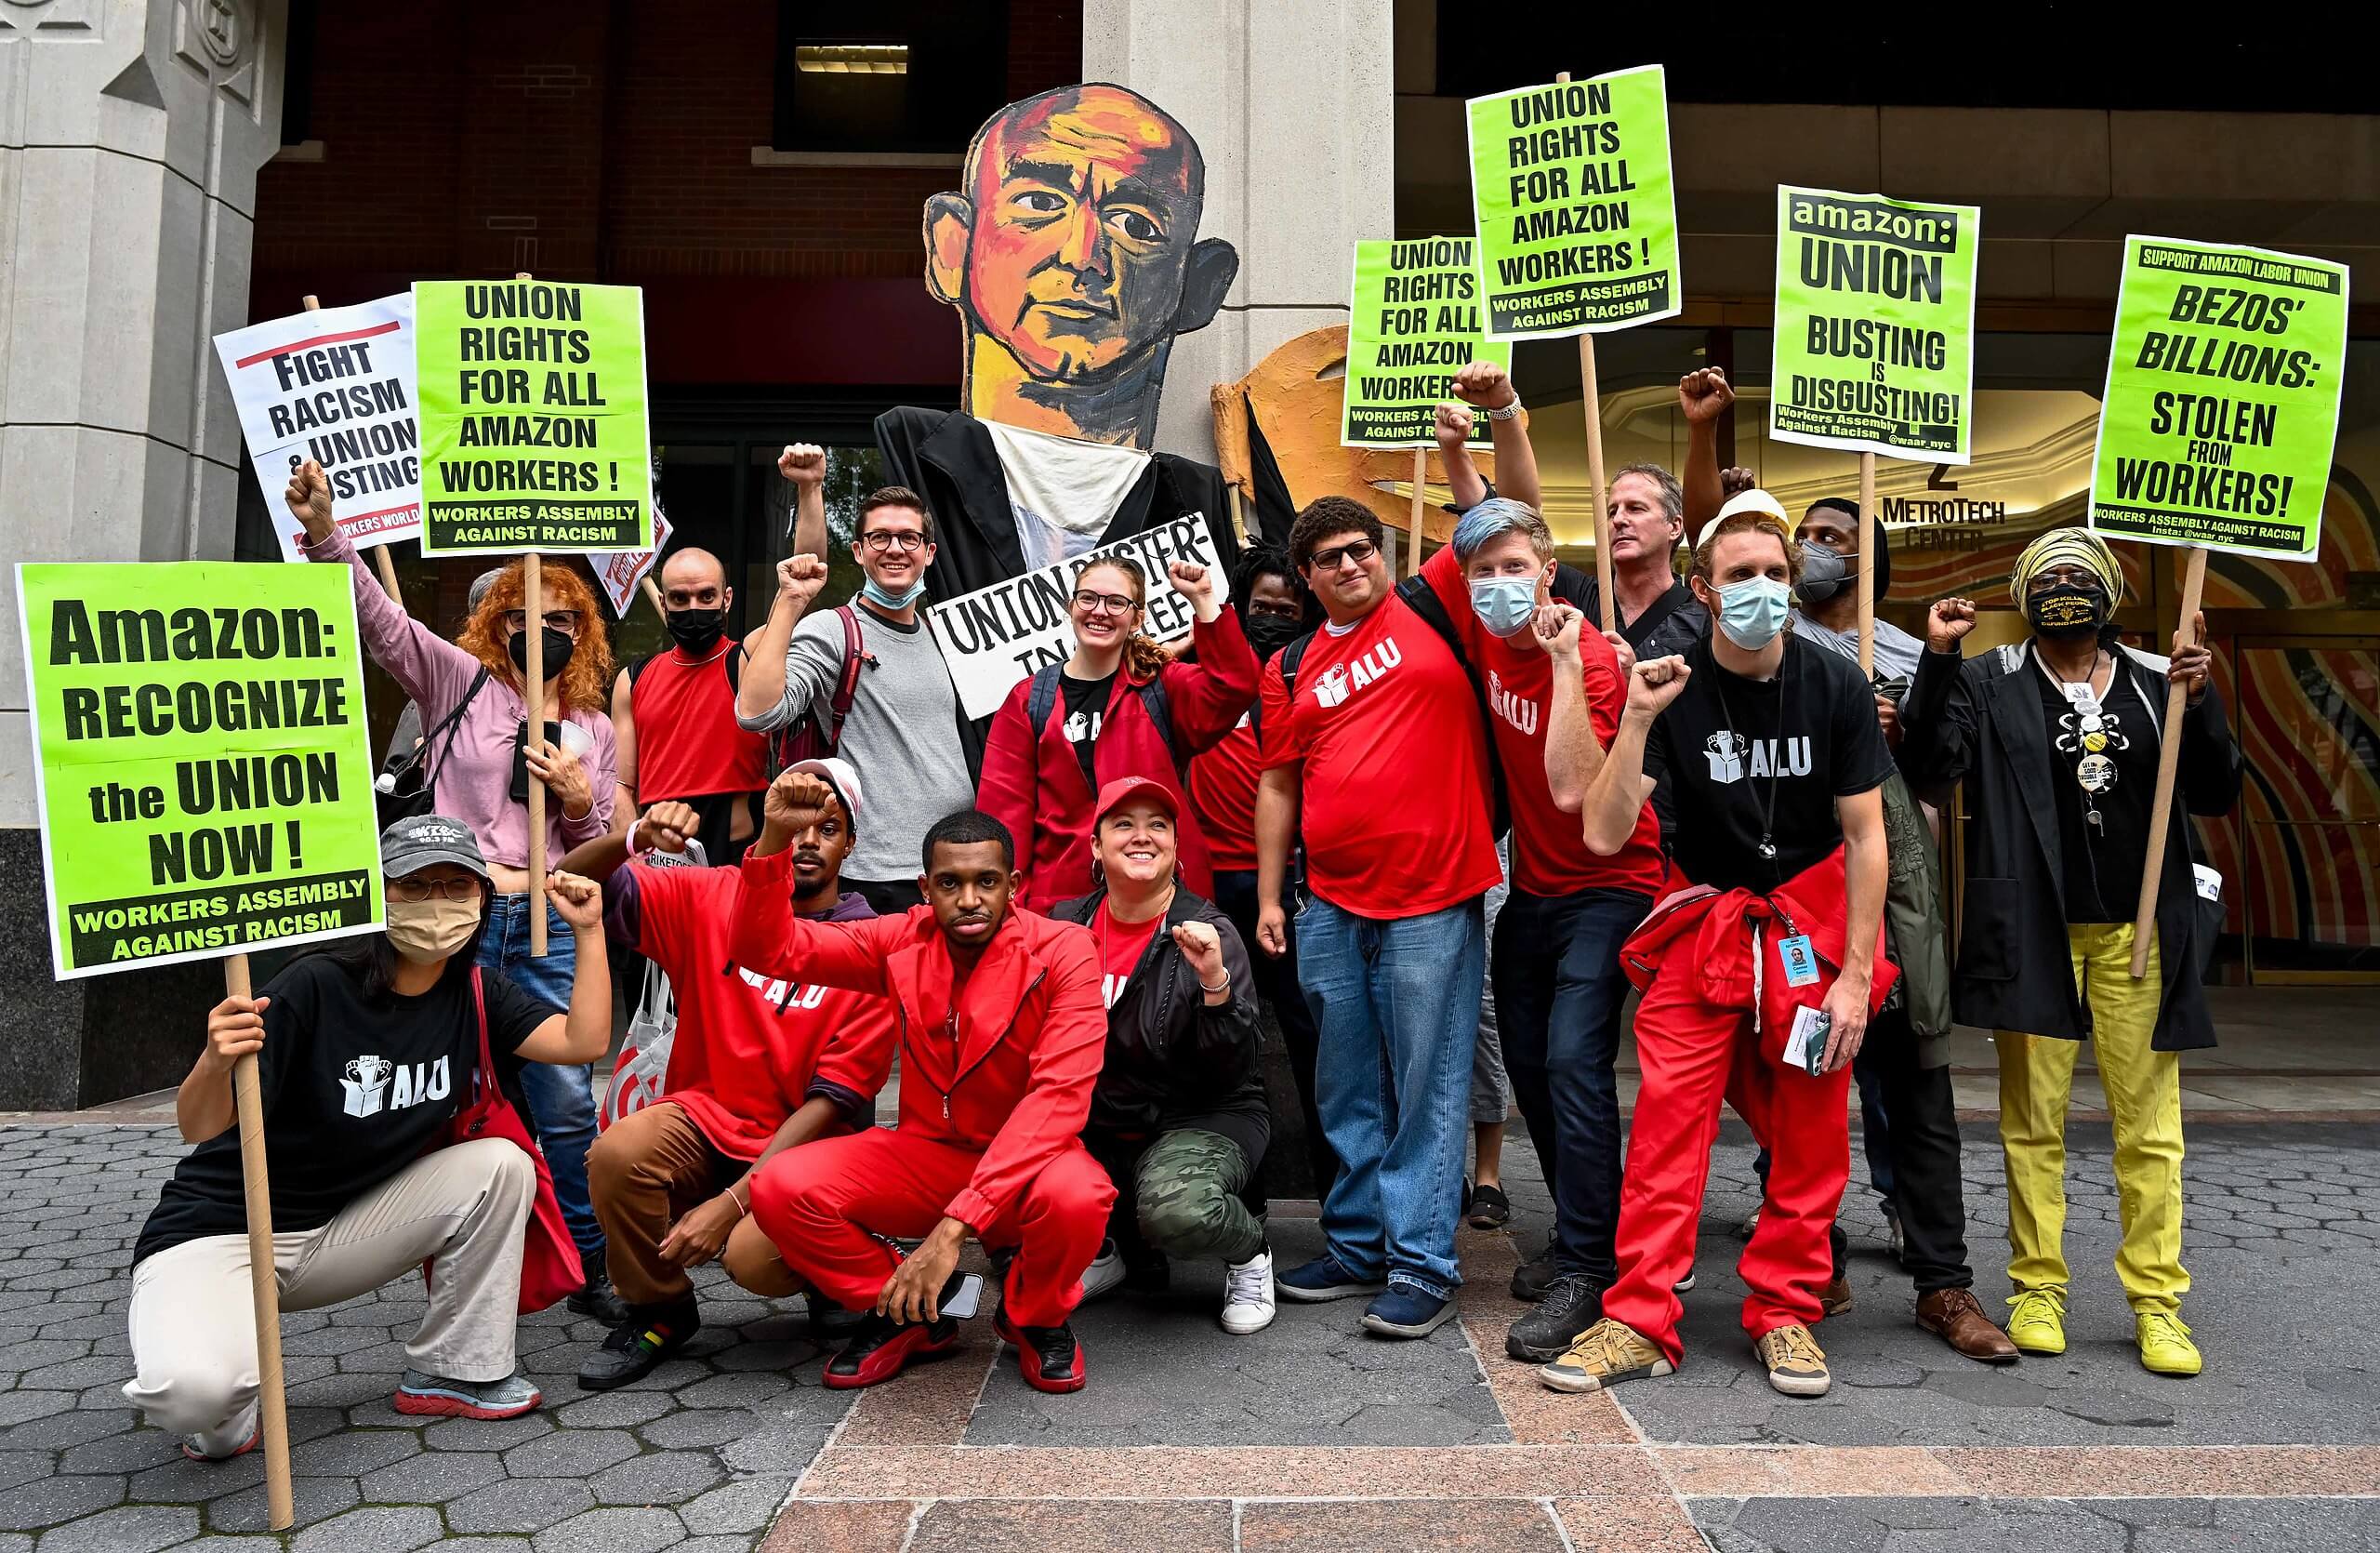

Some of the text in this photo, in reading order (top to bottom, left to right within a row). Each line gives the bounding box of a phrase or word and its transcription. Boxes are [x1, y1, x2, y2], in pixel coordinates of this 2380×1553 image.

[1511, 83, 1610, 128] UNION
[1509, 122, 1620, 167] RIGHTS
[1510, 160, 1635, 207] FOR ALL
[1513, 202, 1630, 244] AMAZON
[1793, 201, 1950, 245] amazon:
[1391, 242, 1471, 270] UNION
[1498, 238, 1649, 286] WORKERS !
[1801, 238, 1942, 304] UNION
[2143, 248, 2329, 289] SUPPORT AMAZON LABOR UNION
[466, 285, 581, 321] UNION
[1384, 273, 1474, 302] RIGHTS
[1492, 276, 1666, 312] WORKERS ASSEMBLY
[1381, 306, 1481, 336] FOR ALL
[1512, 299, 1649, 328] AGAINST RACISM
[461, 327, 589, 364] RIGHTS
[1376, 341, 1473, 367] AMAZON
[1807, 314, 1946, 371] BUSTING
[2135, 331, 2320, 389] BILLIONS:
[272, 342, 373, 392] FIGHT
[1871, 361, 1884, 382] IS
[268, 378, 407, 438] RACISM
[460, 370, 605, 406] FOR ALL
[1361, 375, 1454, 401] WORKER
[1792, 375, 1960, 425] DISGUSTING!
[459, 417, 596, 448] AMAZON
[1352, 410, 1419, 422] WORKERS
[1365, 426, 1422, 438] AGAINST
[1778, 405, 1833, 424] Workers
[1836, 415, 1898, 433] Assembly
[1778, 418, 1951, 450] Against Racism @waar_nyc
[2150, 391, 2277, 447] STOLEN
[309, 418, 416, 469] UNION
[2187, 439, 2232, 467] FROM
[325, 456, 417, 502] STING
[440, 461, 618, 493] WORKERS !
[2116, 457, 2294, 518] WORKERS!
[340, 508, 419, 538] RKERS WORLD
[431, 506, 636, 523] WORKERS ASSEMBLY
[454, 526, 617, 542] AGAINST RACISM
[2094, 508, 2301, 541] WORKERS ASSEMBLY AGAINST RACISM
[2152, 525, 2182, 537] Insta:
[1906, 525, 1984, 551] CENTER
[937, 565, 1071, 654] UNION
[50, 600, 336, 665] Amazon:
[1350, 637, 1403, 692] ALU
[62, 678, 348, 740] RECOGNIZE
[1503, 690, 1538, 736] ALU
[1751, 736, 1812, 777] ALU
[88, 752, 340, 823] the UNION
[149, 821, 302, 885] NOW !
[74, 877, 366, 933] WORKERS ASSEMBLY
[112, 909, 342, 961] AGAINST RACISM
[390, 1055, 451, 1111] ALU
